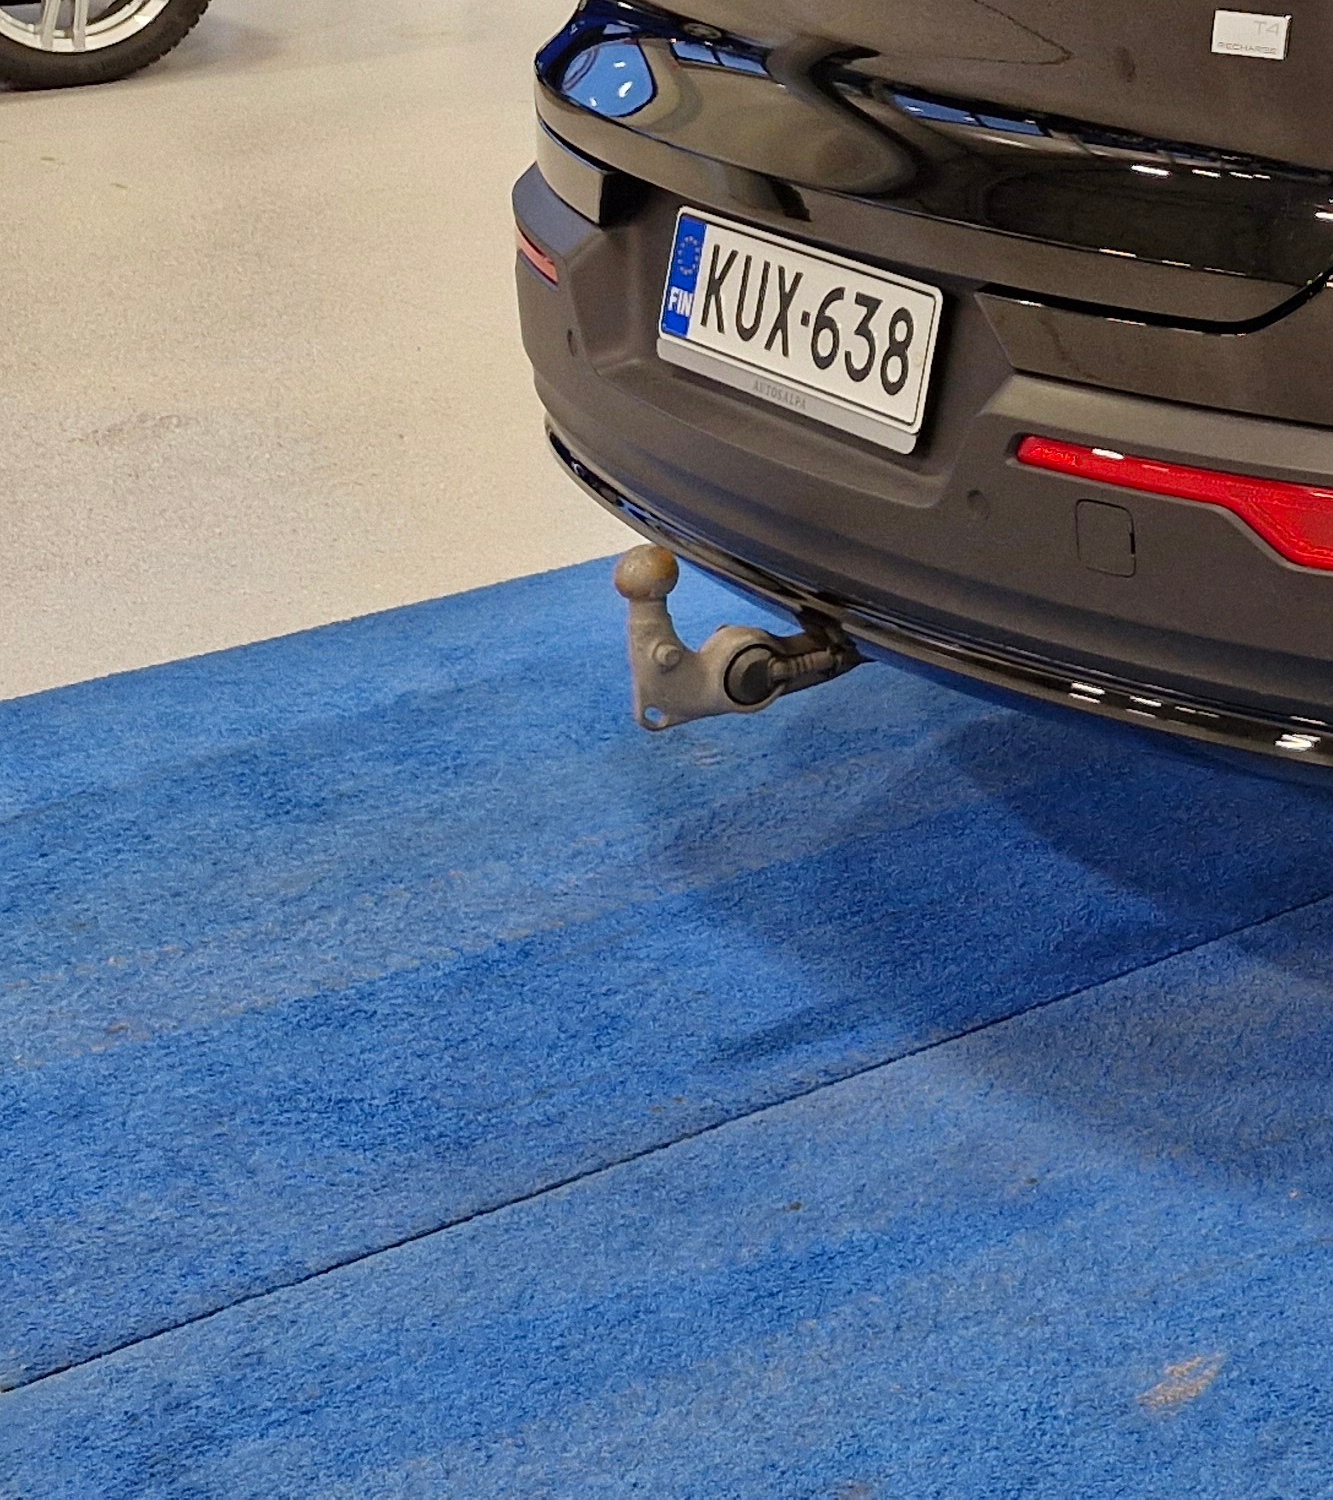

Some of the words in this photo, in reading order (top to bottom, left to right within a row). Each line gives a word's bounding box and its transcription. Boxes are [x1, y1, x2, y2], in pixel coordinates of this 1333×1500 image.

[1253, 20, 1280, 37] T4
[668, 285, 694, 318] FIN
[700, 243, 915, 396] KUX-638
